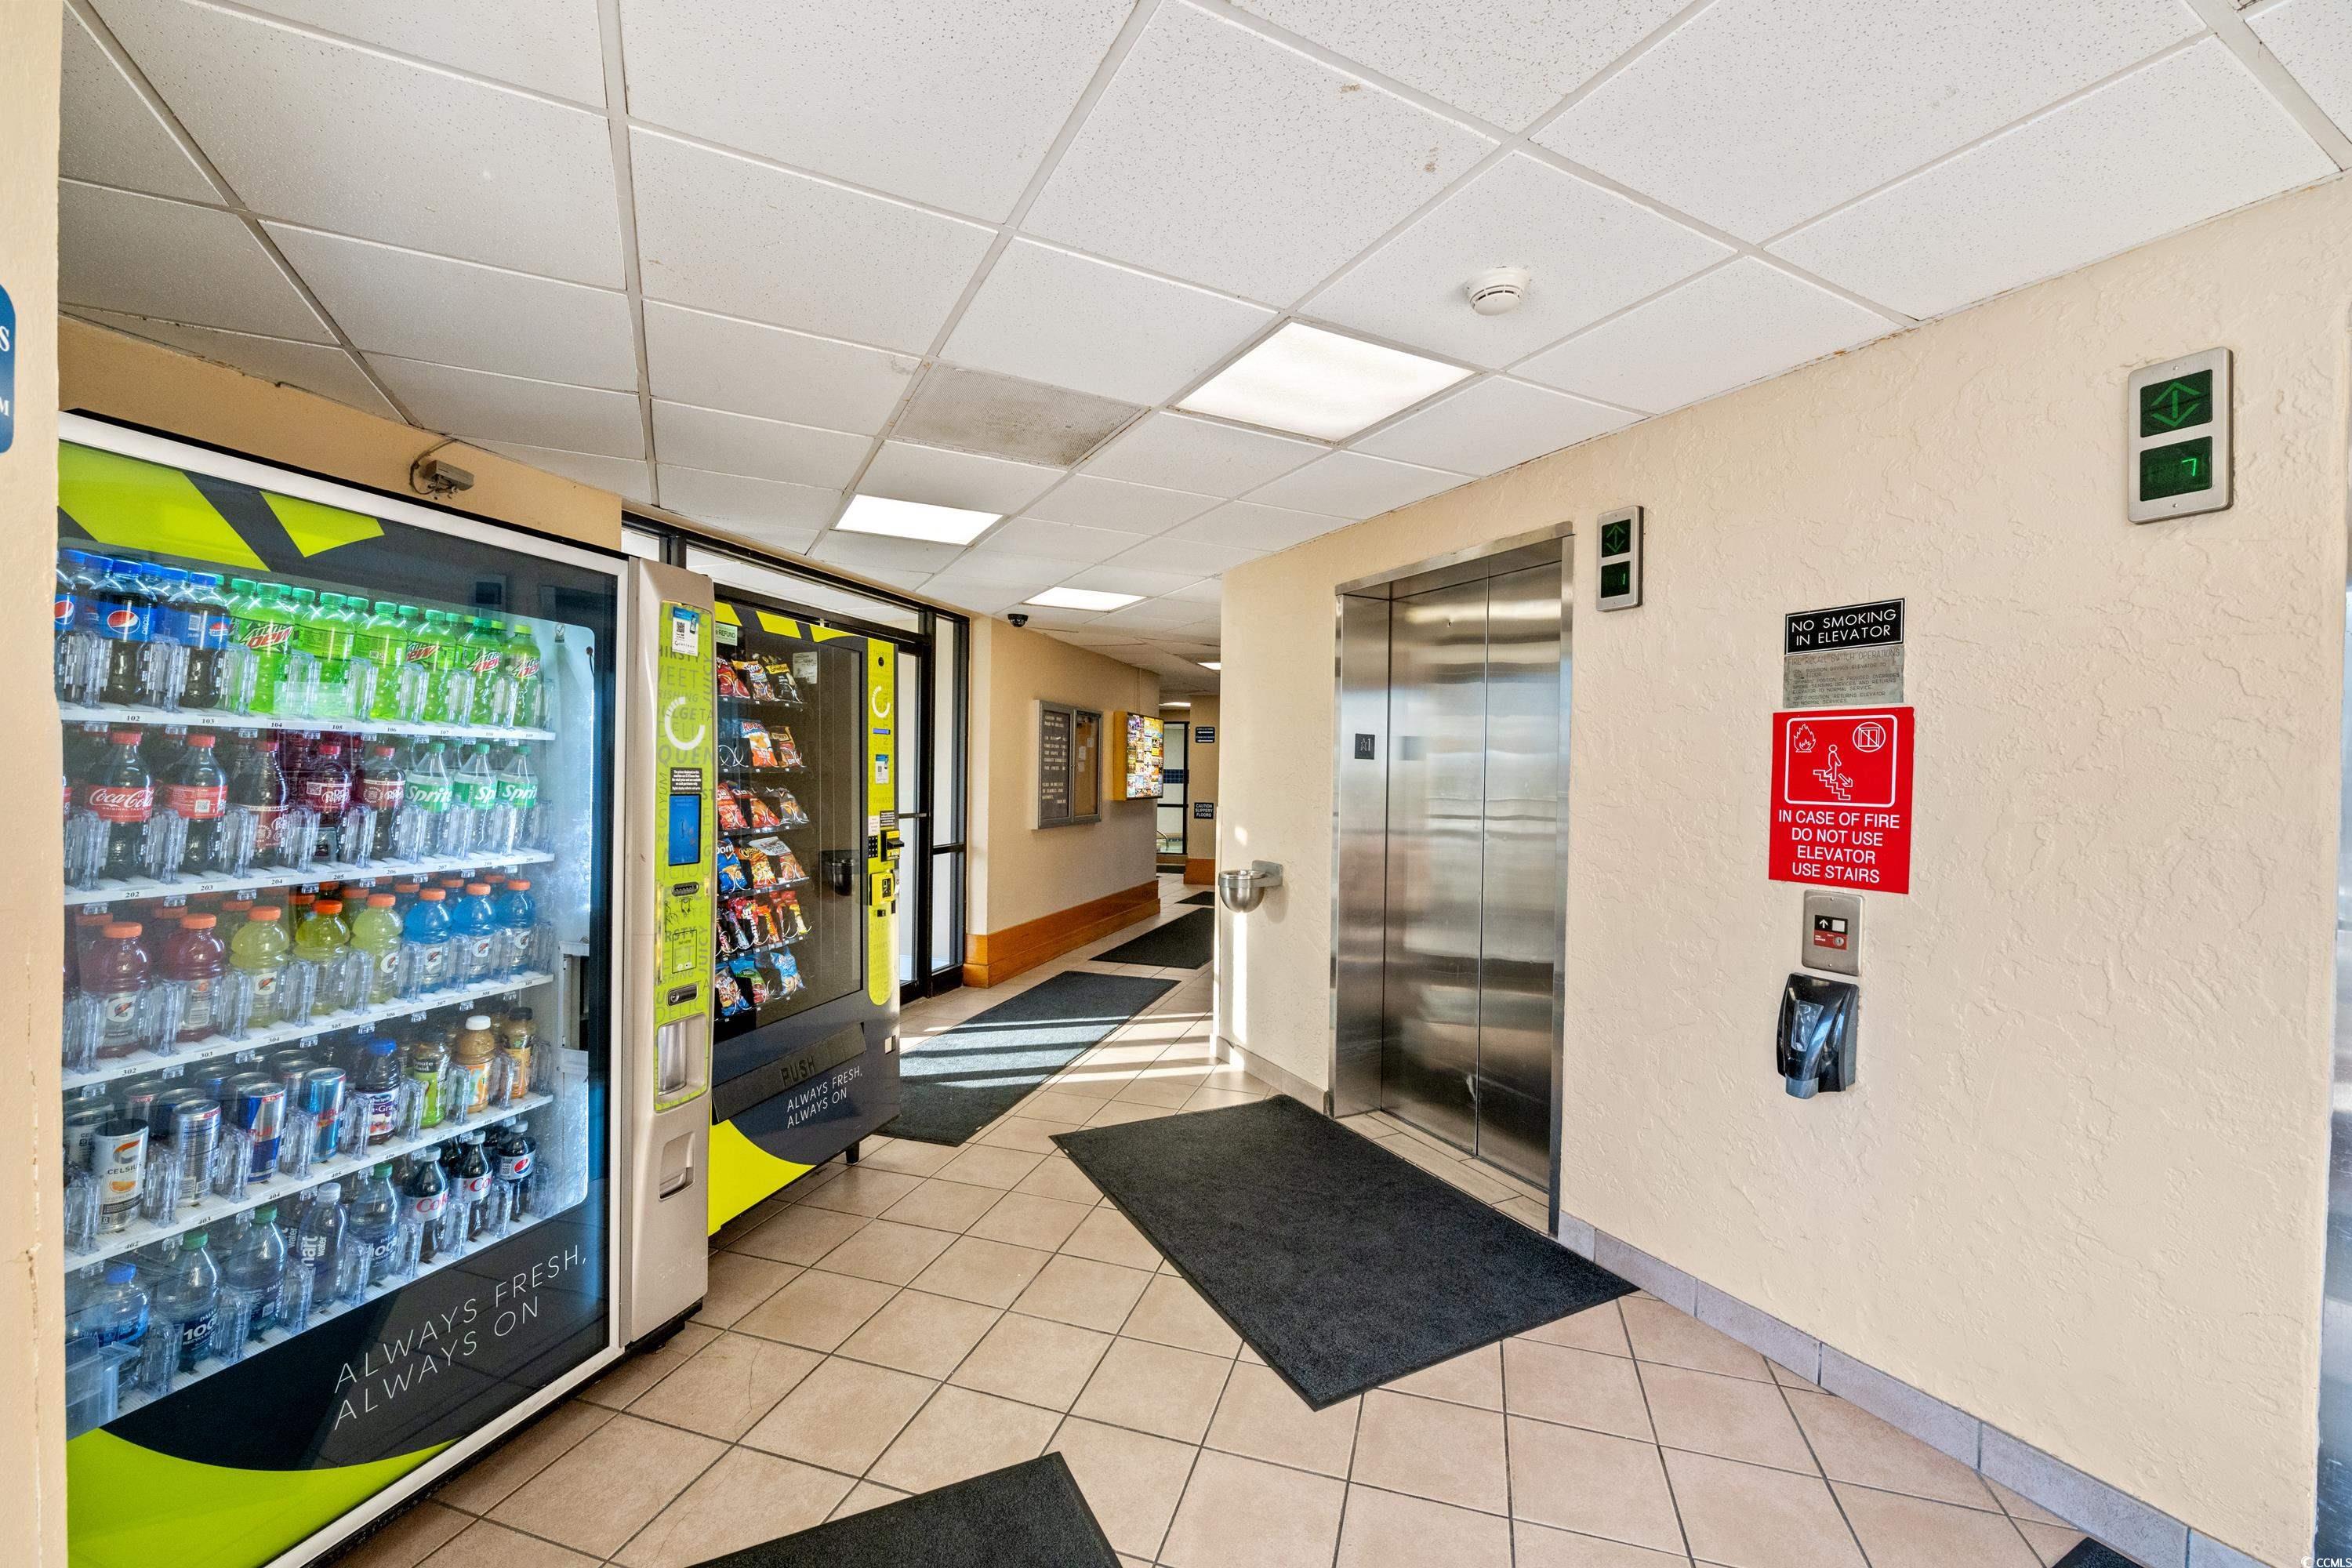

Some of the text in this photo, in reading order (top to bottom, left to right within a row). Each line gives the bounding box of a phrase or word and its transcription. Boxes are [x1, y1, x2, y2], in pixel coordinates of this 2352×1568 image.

[2182, 459, 2197, 477] 7
[1791, 609, 1896, 633] NO SMOKING
[718, 630, 735, 638] REFUND
[1796, 625, 1890, 646] IN ELEVATOR
[1788, 657, 1802, 666] FIRE
[1831, 652, 1855, 663] SWITCH
[1858, 648, 1900, 660] OPERATIONS
[1778, 809, 1900, 829] IN CASE OF FIRE
[1791, 827, 1883, 847] DO NOT USE
[1797, 845, 1876, 865] ELEVATOR
[1792, 862, 1880, 884] USE STAIRS
[780, 1054, 816, 1088] PUSH
[787, 1065, 862, 1112] ALWAYS FRESH,
[787, 1087, 847, 1129] ALWAYS ON
[107, 1163, 142, 1175] CELSIUS
[288, 1228, 298, 1249] water
[317, 1236, 327, 1257] water
[334, 1245, 587, 1394] ALWAYS FRESH,
[334, 1296, 539, 1431] ALWAYS ON
